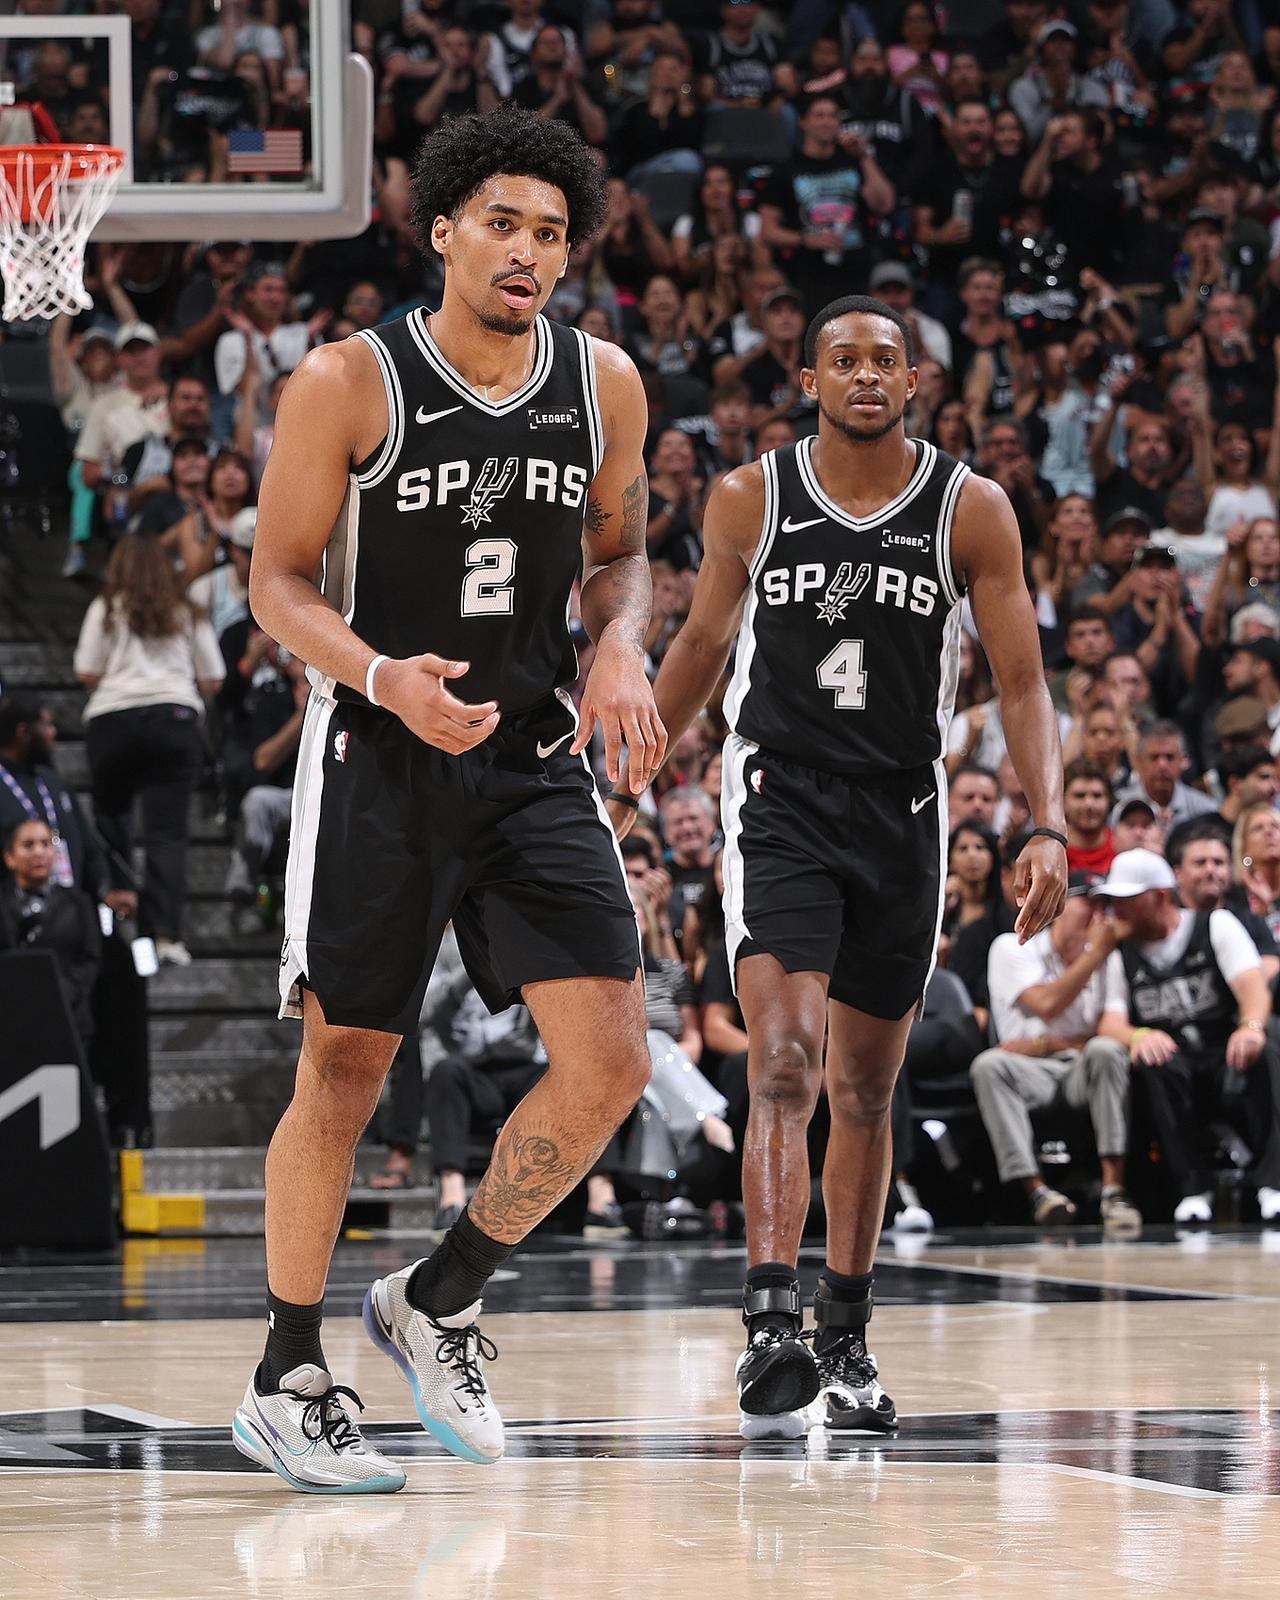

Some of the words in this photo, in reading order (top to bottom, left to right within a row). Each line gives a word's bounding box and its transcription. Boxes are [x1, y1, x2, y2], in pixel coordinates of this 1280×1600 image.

[535, 413, 573, 425] LEDGER
[396, 457, 588, 530] SPURS
[887, 534, 924, 548] LEDGER
[460, 537, 519, 618] 2
[763, 562, 939, 626] SPURS
[815, 638, 868, 710] 4
